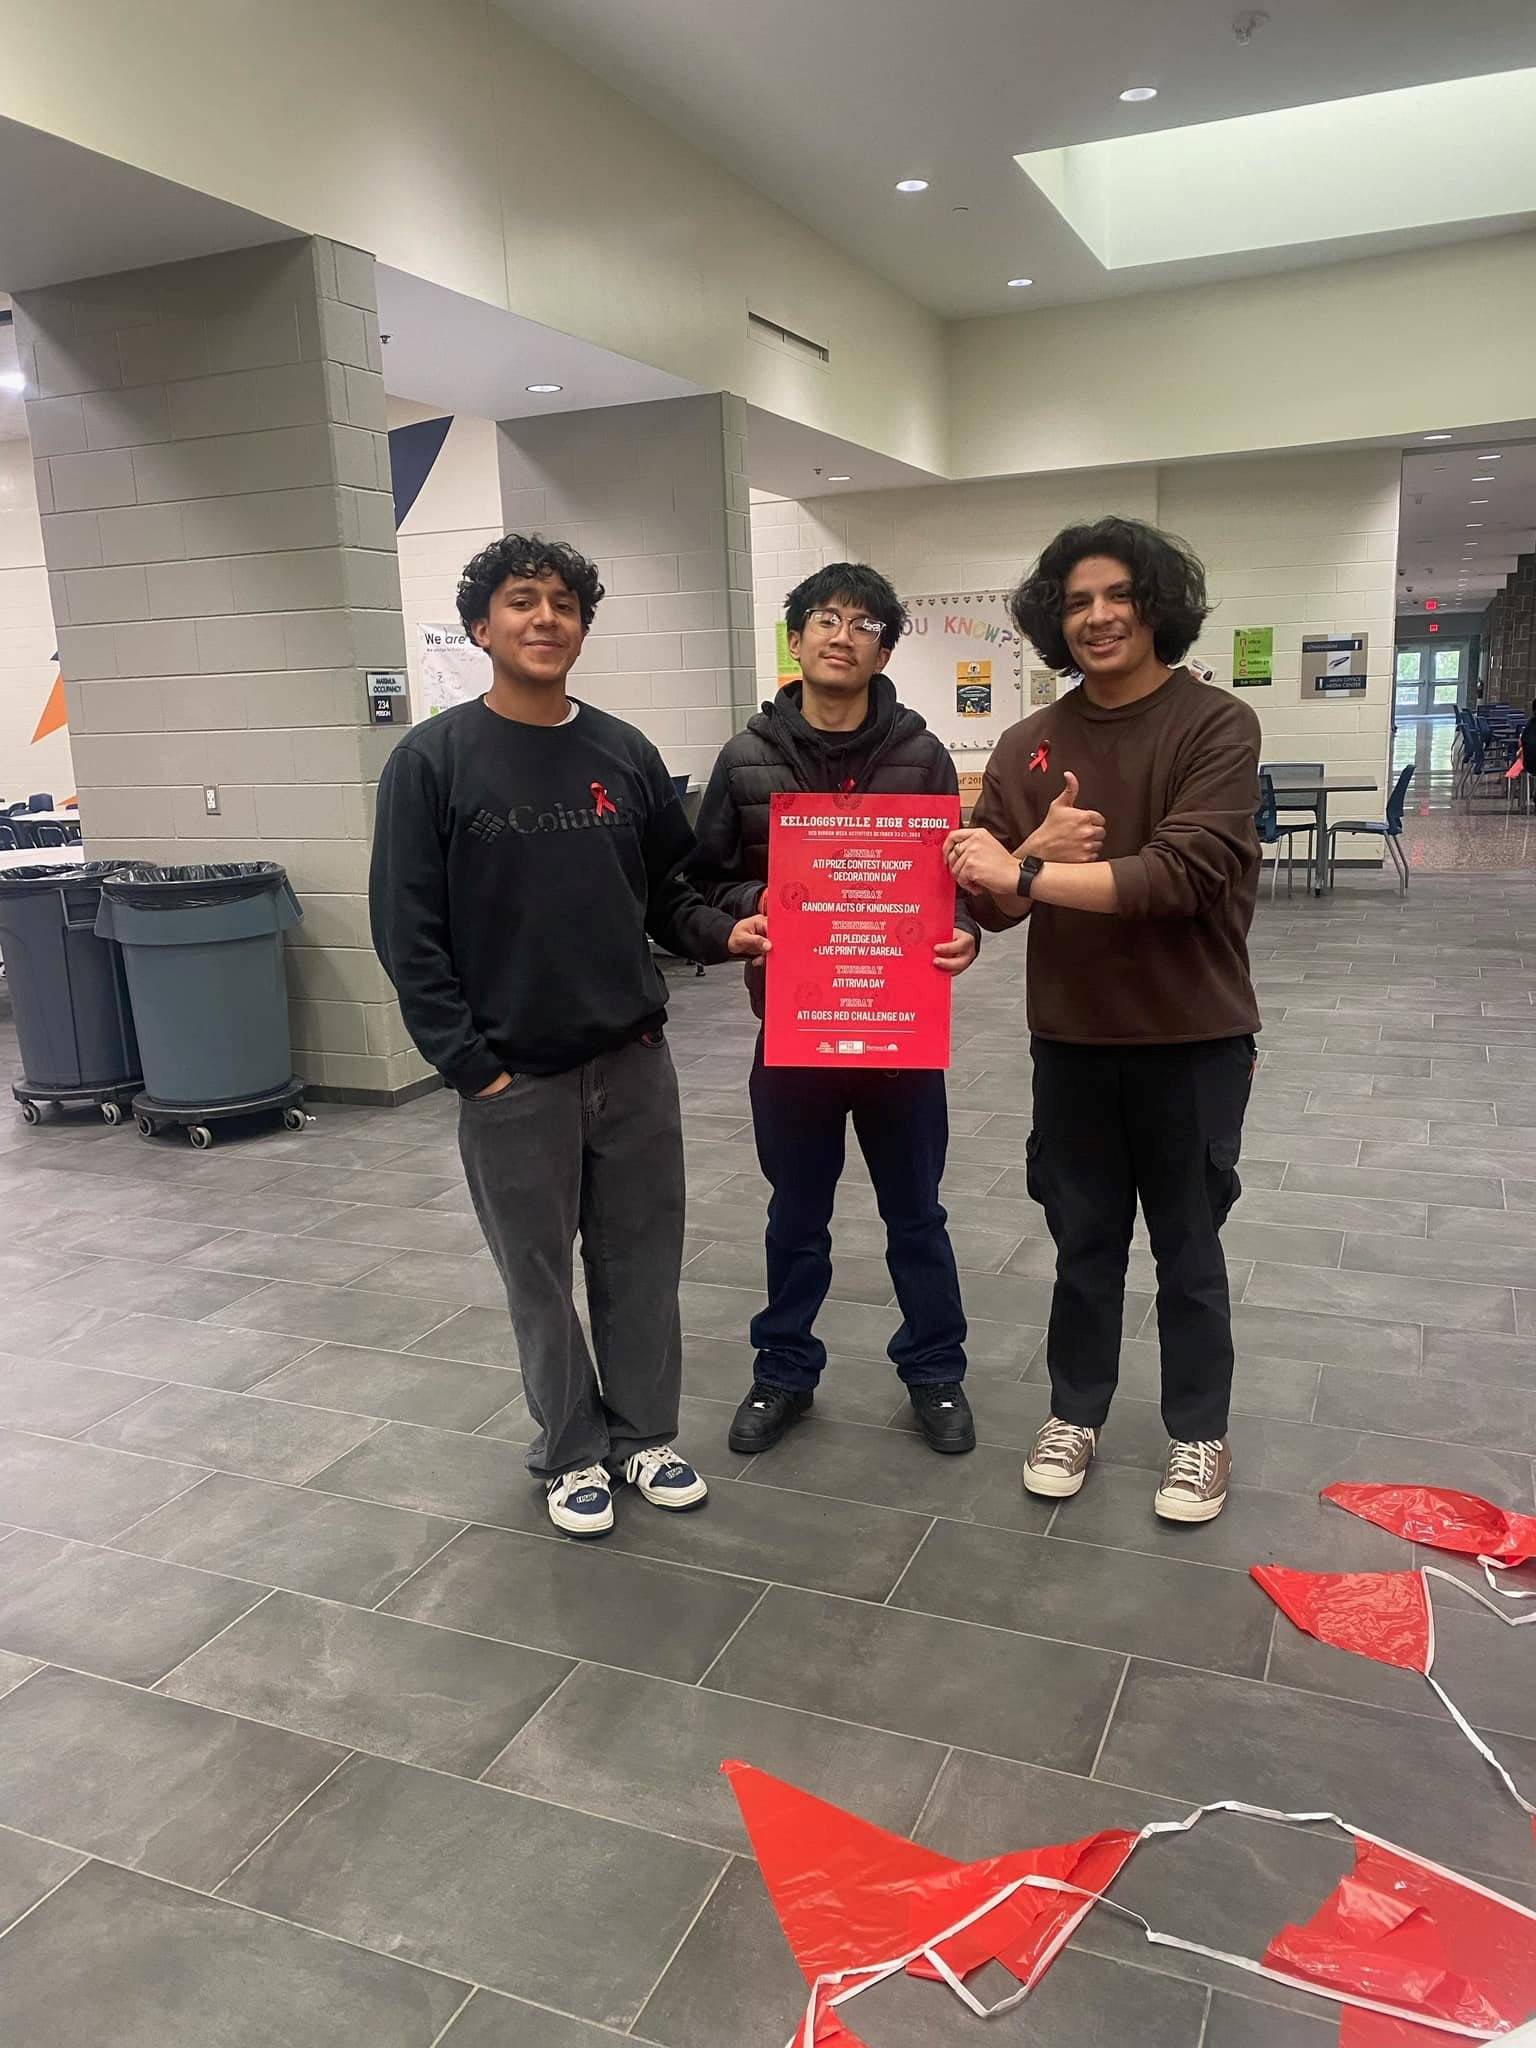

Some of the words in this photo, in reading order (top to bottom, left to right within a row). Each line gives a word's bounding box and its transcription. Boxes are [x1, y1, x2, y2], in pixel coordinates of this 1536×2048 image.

[901, 615, 928, 636] OU
[425, 633, 441, 645] We
[445, 635, 466, 645] are
[377, 700, 389, 709] 234
[780, 816, 871, 828] KELLOGGSVILLE
[875, 817, 903, 828] HIGH
[908, 818, 950, 829] SCHOOL
[813, 859, 825, 869] ATI
[825, 859, 847, 869] PRIZE
[848, 860, 881, 870] CONTEST
[881, 860, 912, 870] KICKOFF
[833, 872, 880, 881] DECORATION
[881, 873, 897, 882] DAY
[802, 902, 835, 912] RANDOM
[835, 903, 855, 912] ACTS
[856, 903, 866, 912] OF
[866, 903, 903, 913] KINDNESS
[904, 904, 921, 914] DAY
[830, 934, 842, 943] ATI
[842, 934, 870, 943] PLEDGE
[871, 935, 887, 944] DAY
[818, 946, 834, 955] LIVE
[834, 946, 856, 955] PRINT
[857, 946, 869, 956] W/
[870, 946, 904, 956] BAREALL
[832, 978, 844, 988] ATI
[845, 978, 868, 988] TRIVIA
[869, 979, 885, 988] DAY
[797, 1010, 810, 1020] ATI
[811, 1010, 832, 1020] GOES
[833, 1011, 850, 1020] RED
[851, 1011, 898, 1021] CHALLENGE
[899, 1012, 915, 1021] DAY
